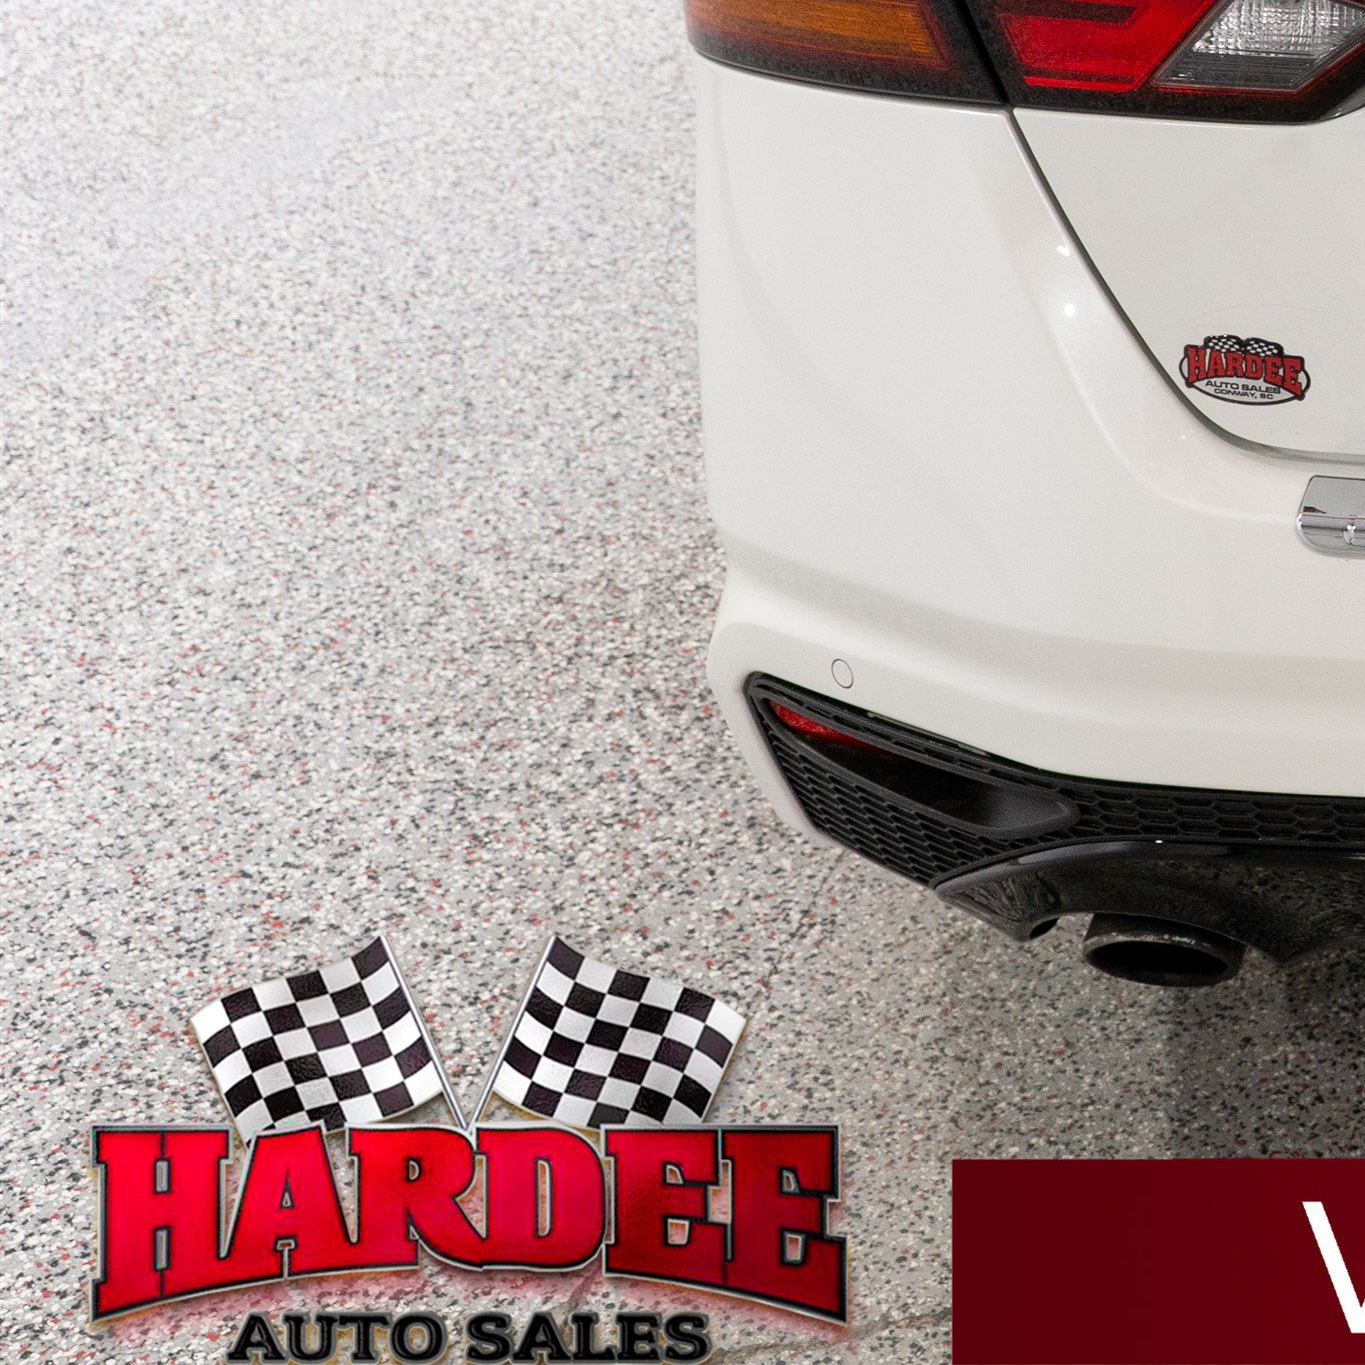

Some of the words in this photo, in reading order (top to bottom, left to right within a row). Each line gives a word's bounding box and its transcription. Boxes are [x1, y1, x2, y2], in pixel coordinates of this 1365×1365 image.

[1186, 345, 1303, 398] HARDEE
[1205, 380, 1239, 390] AUTO
[1241, 384, 1281, 394] SALES
[1213, 388, 1258, 399] CONWAY,
